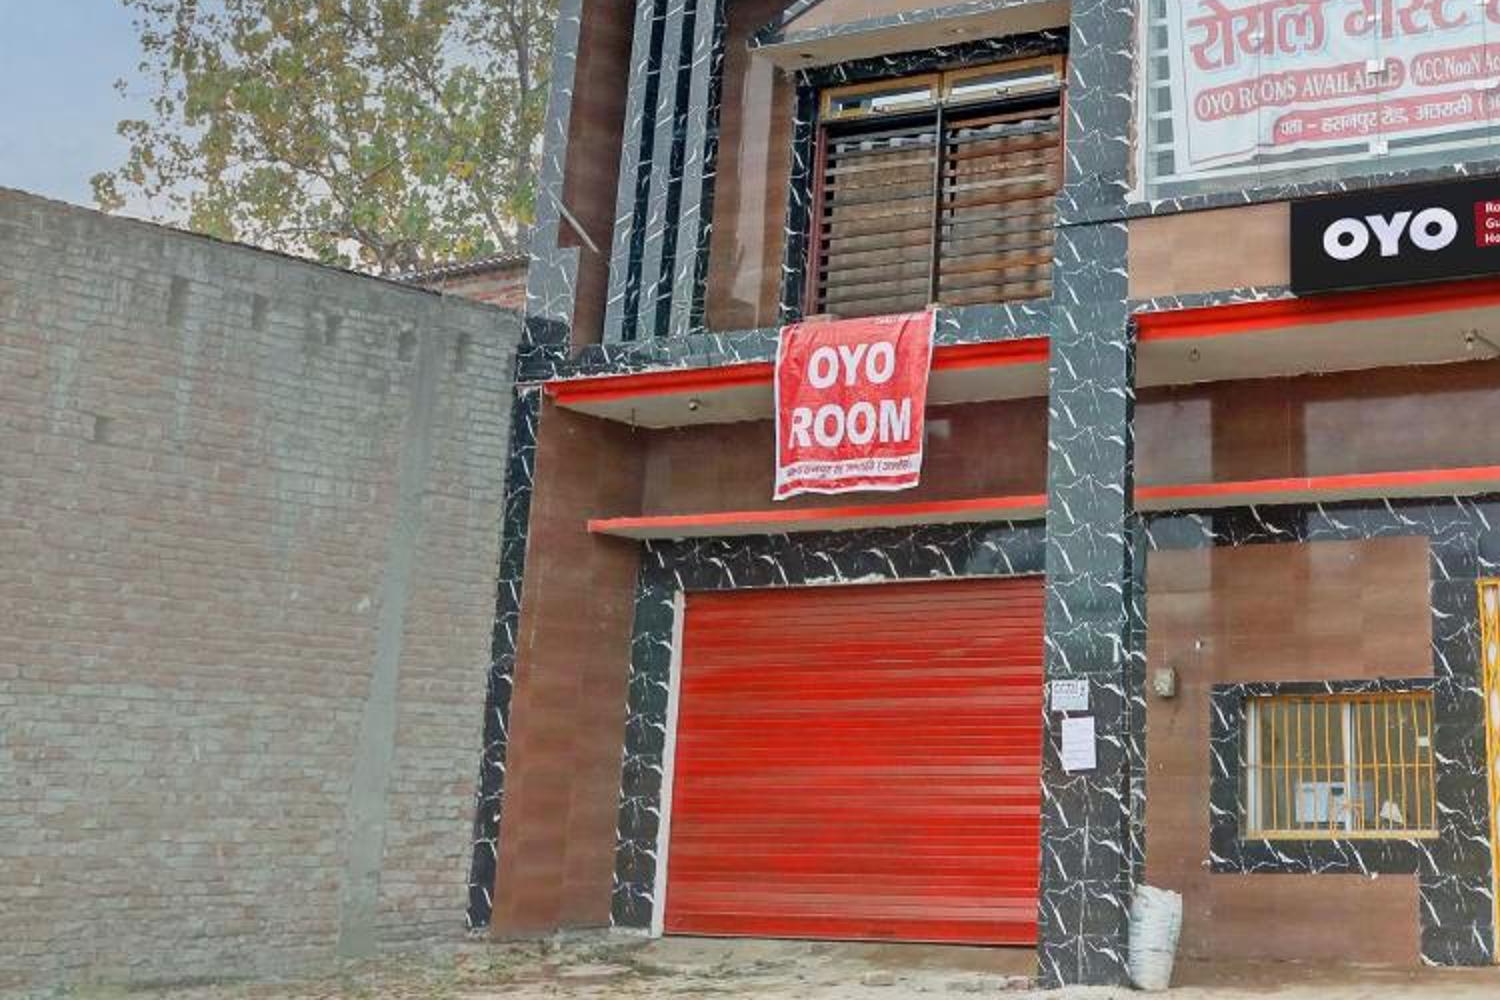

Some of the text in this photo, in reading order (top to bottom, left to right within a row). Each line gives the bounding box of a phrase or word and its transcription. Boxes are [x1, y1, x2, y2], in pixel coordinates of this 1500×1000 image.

[1197, 90, 1236, 118] OYO
[1322, 207, 1458, 261] OYO
[808, 341, 896, 389] OYO
[788, 397, 912, 449] ROOM
